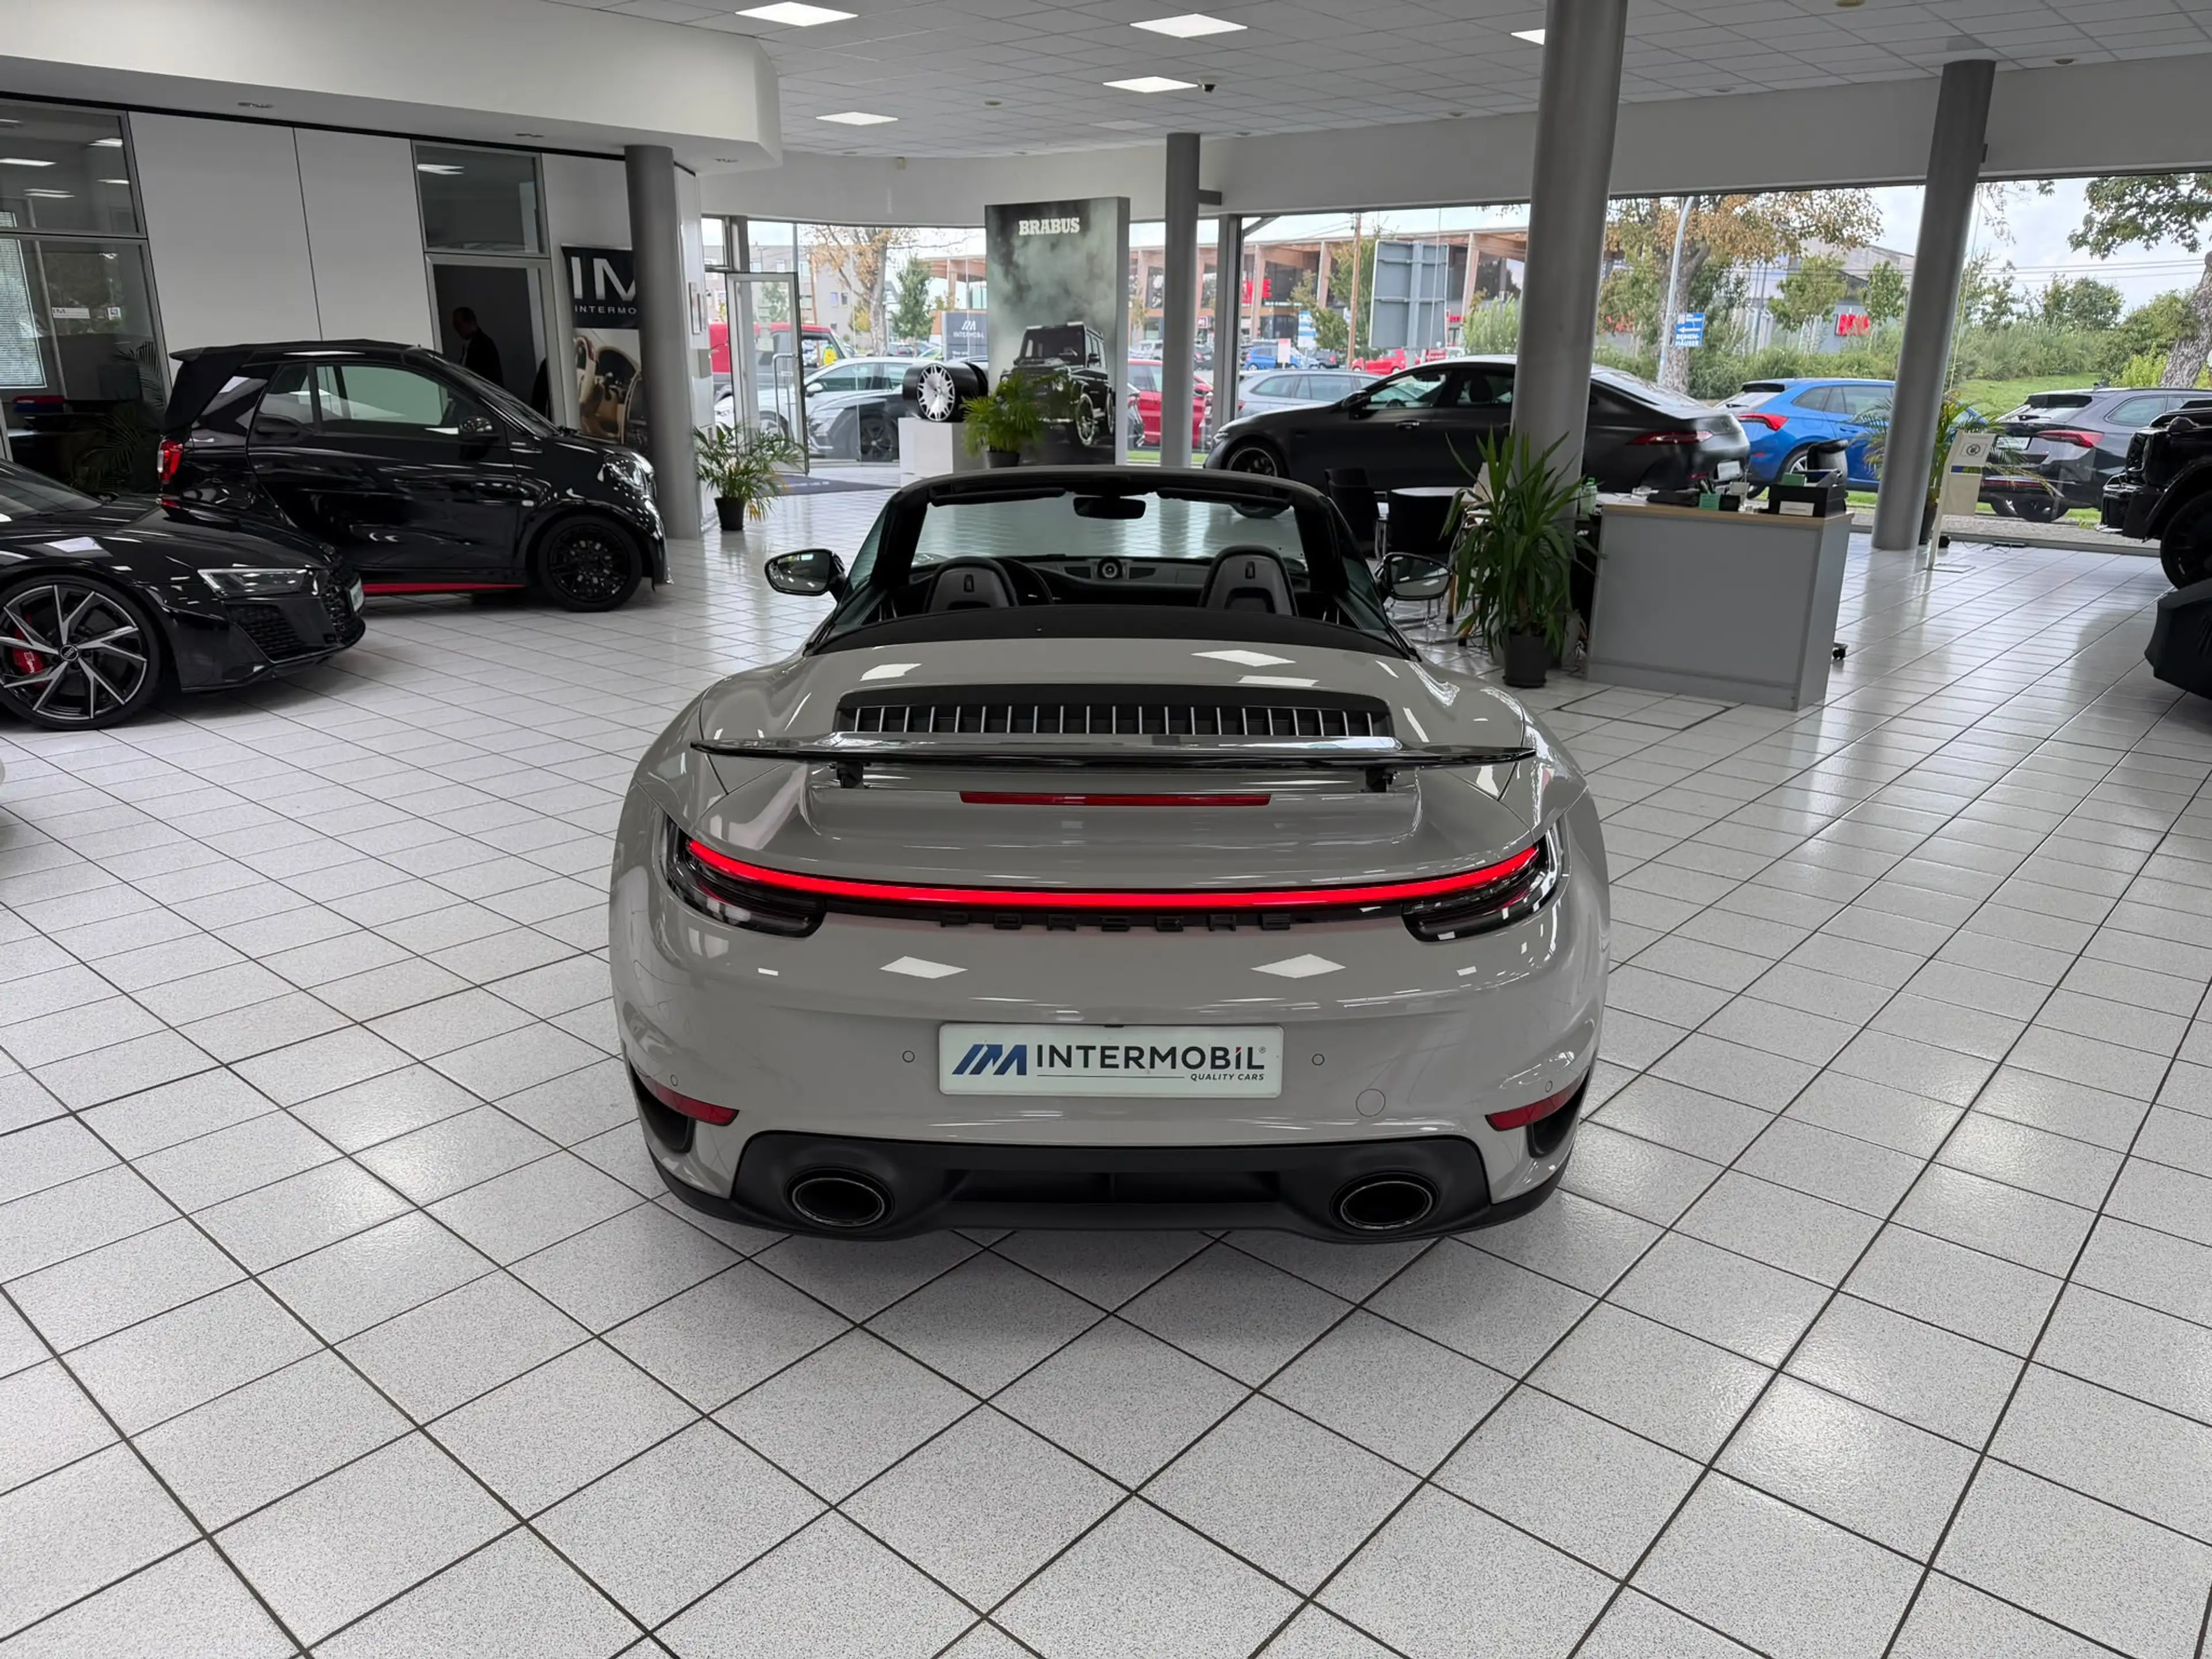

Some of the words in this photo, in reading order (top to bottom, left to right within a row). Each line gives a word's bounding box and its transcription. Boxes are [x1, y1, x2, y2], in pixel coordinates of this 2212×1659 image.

[1018, 217, 1080, 236] BRABUS
[574, 305, 637, 315] INTERMO
[941, 911, 1290, 932] PORSCHE
[1190, 1073, 1234, 1081] QUALITY
